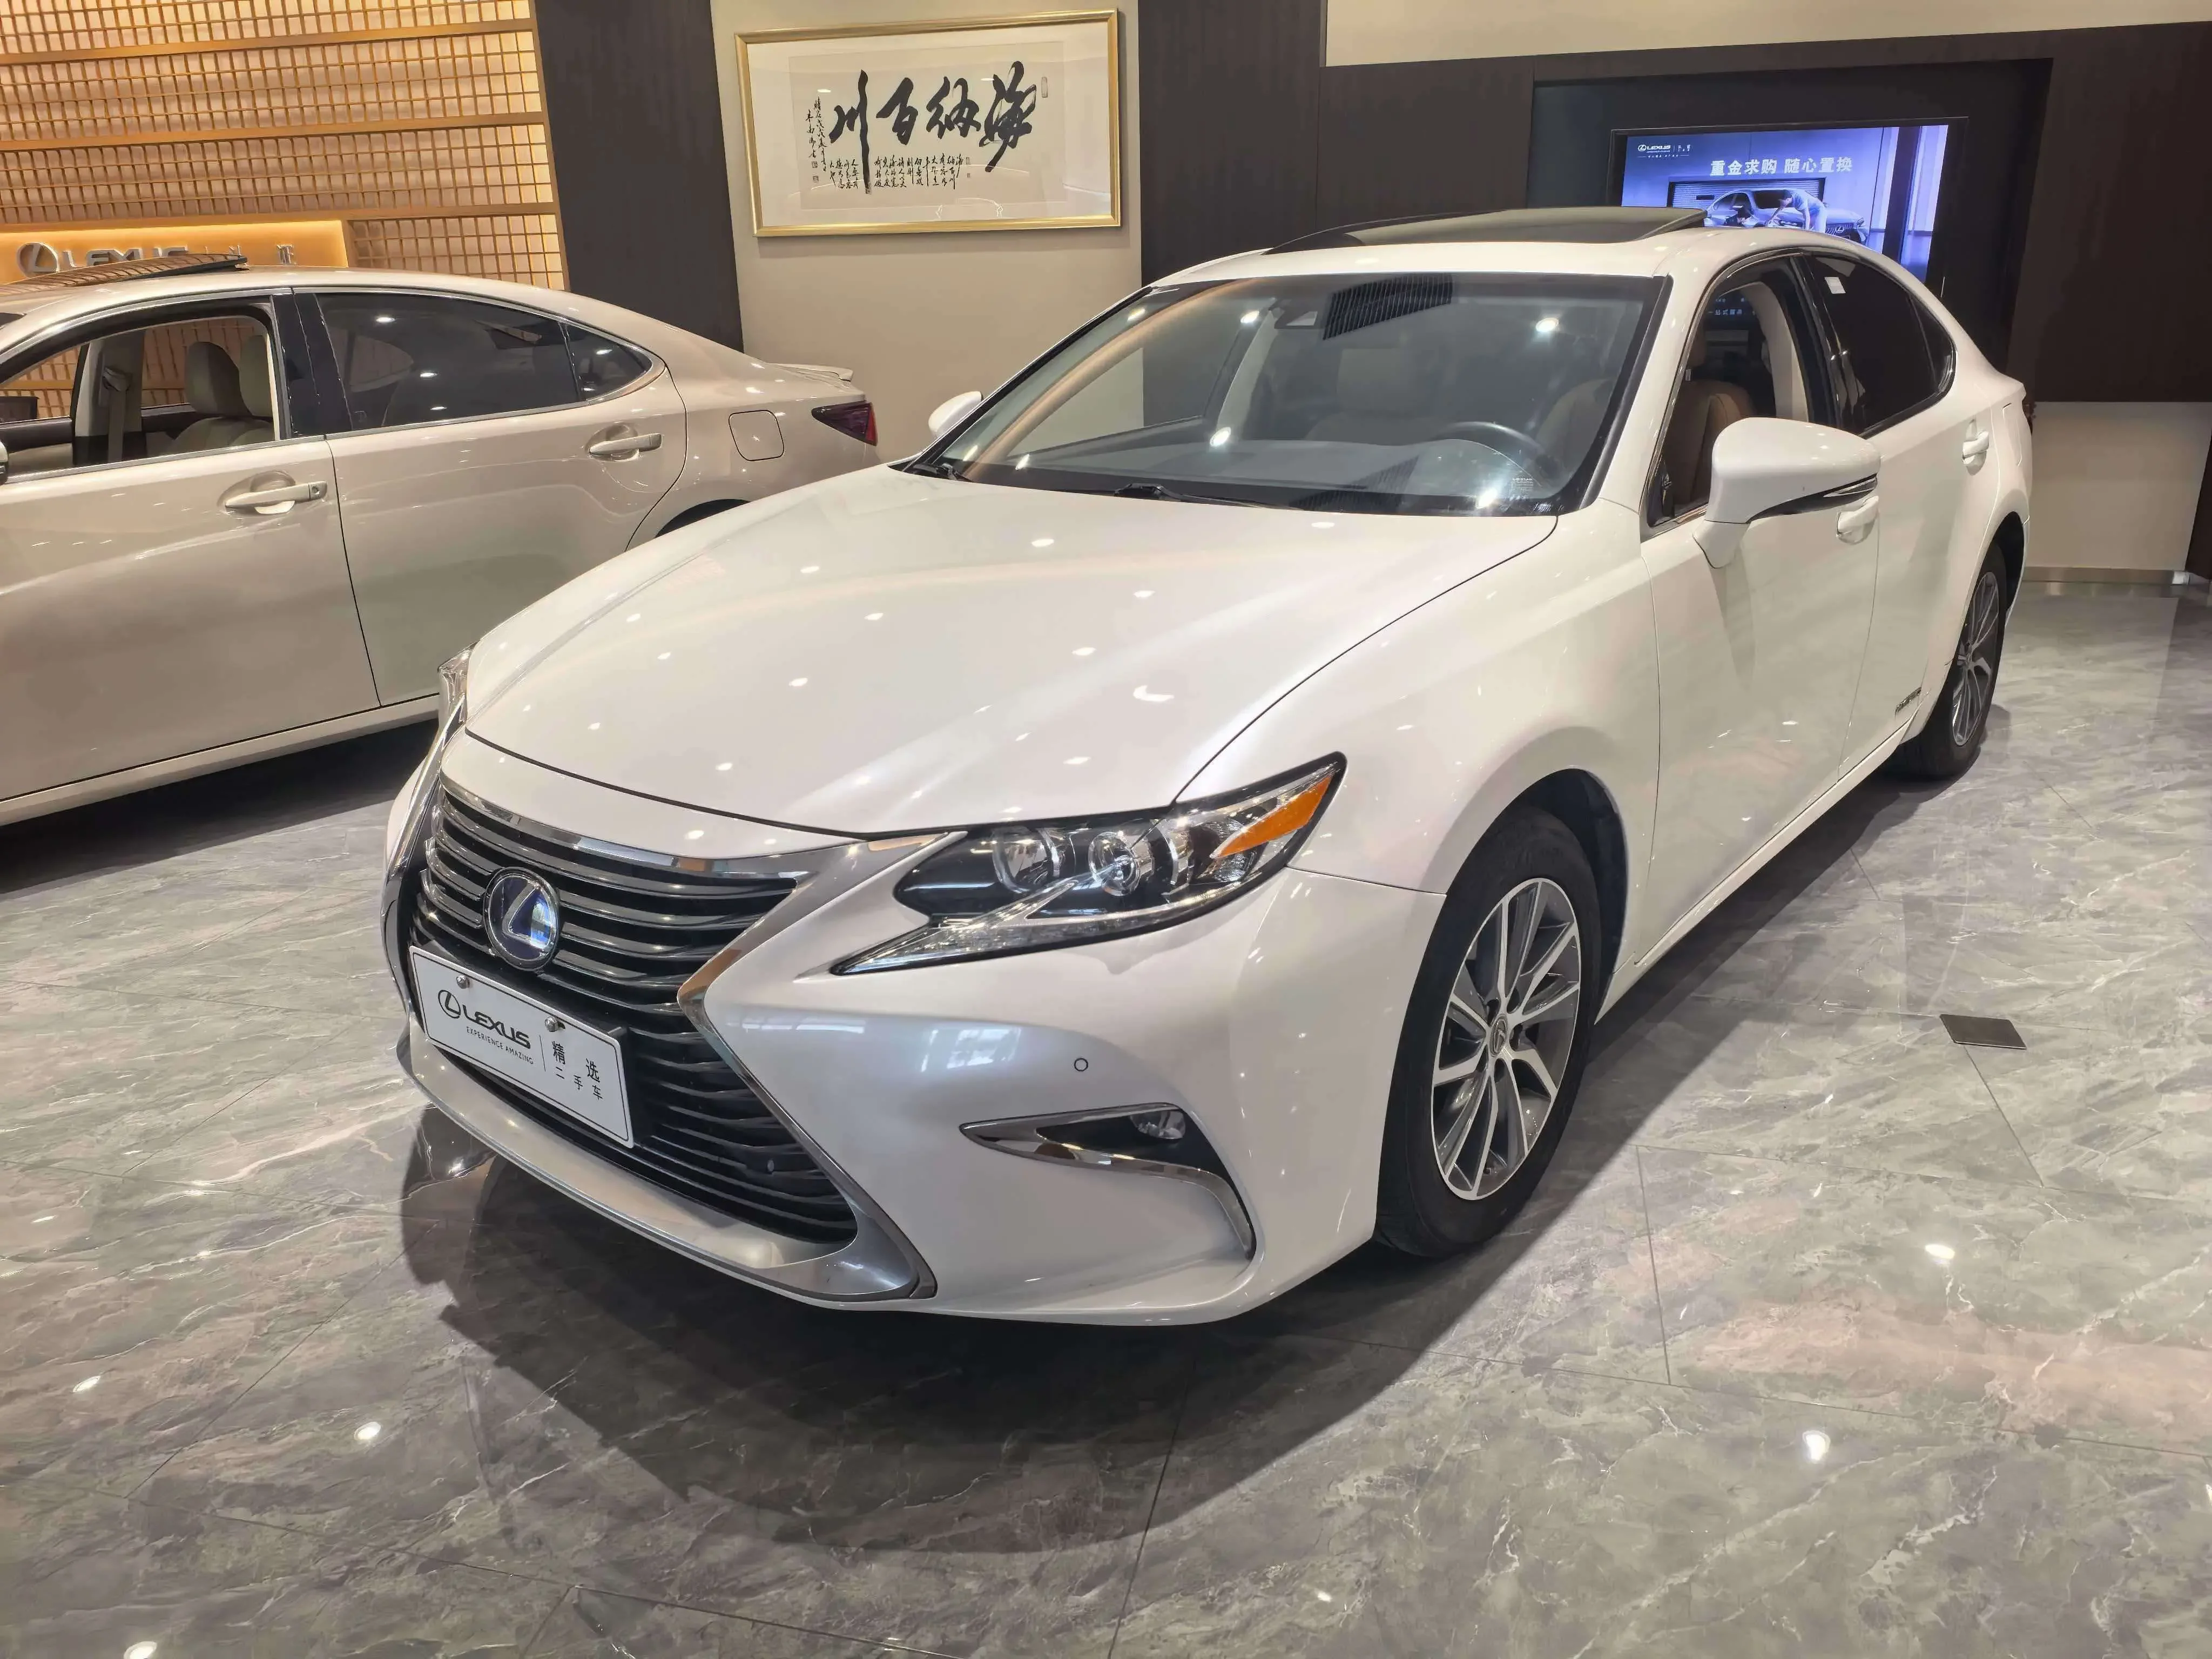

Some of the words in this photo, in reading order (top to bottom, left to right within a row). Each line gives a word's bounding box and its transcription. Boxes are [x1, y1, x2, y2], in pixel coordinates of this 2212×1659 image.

[1710, 159, 1777, 177] 重金求购
[1784, 157, 1852, 173] 随心置换
[462, 1004, 531, 1049] LEXUS
[466, 1026, 504, 1049] EXPERIENCE
[505, 1047, 534, 1064] AMAZING
